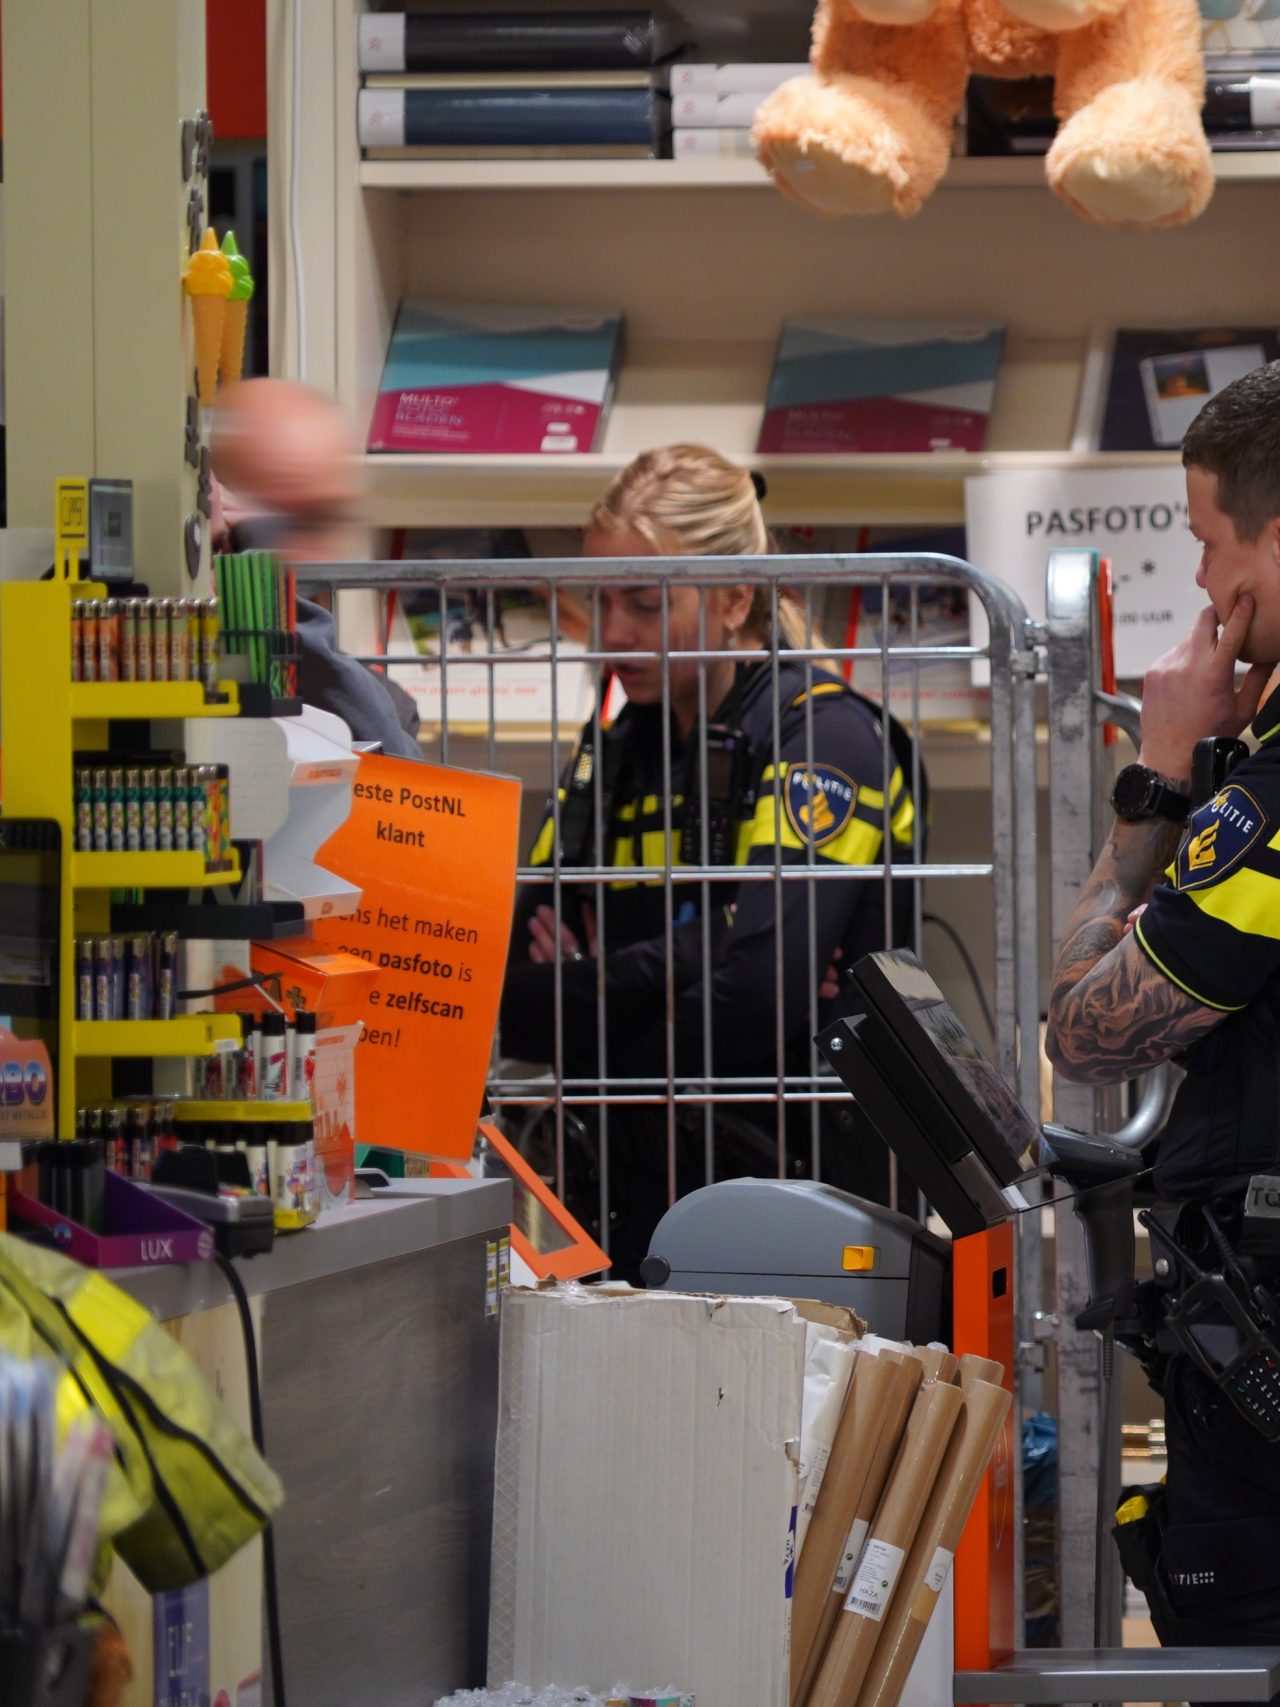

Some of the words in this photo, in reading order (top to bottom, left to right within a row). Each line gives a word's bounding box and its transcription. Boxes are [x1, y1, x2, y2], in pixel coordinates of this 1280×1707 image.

[353, 782, 393, 803] este
[400, 787, 466, 817] PostNL
[1211, 794, 1254, 834] OLITIE
[376, 820, 425, 848] klant
[377, 907, 408, 932] het
[414, 919, 478, 944] maken
[378, 951, 452, 978] pasfoto
[458, 962, 473, 982] is
[385, 991, 464, 1020] zelfscan
[0, 1060, 47, 1105] BO
[140, 1239, 173, 1260] LUX
[859, 1587, 878, 1599] HAZA
